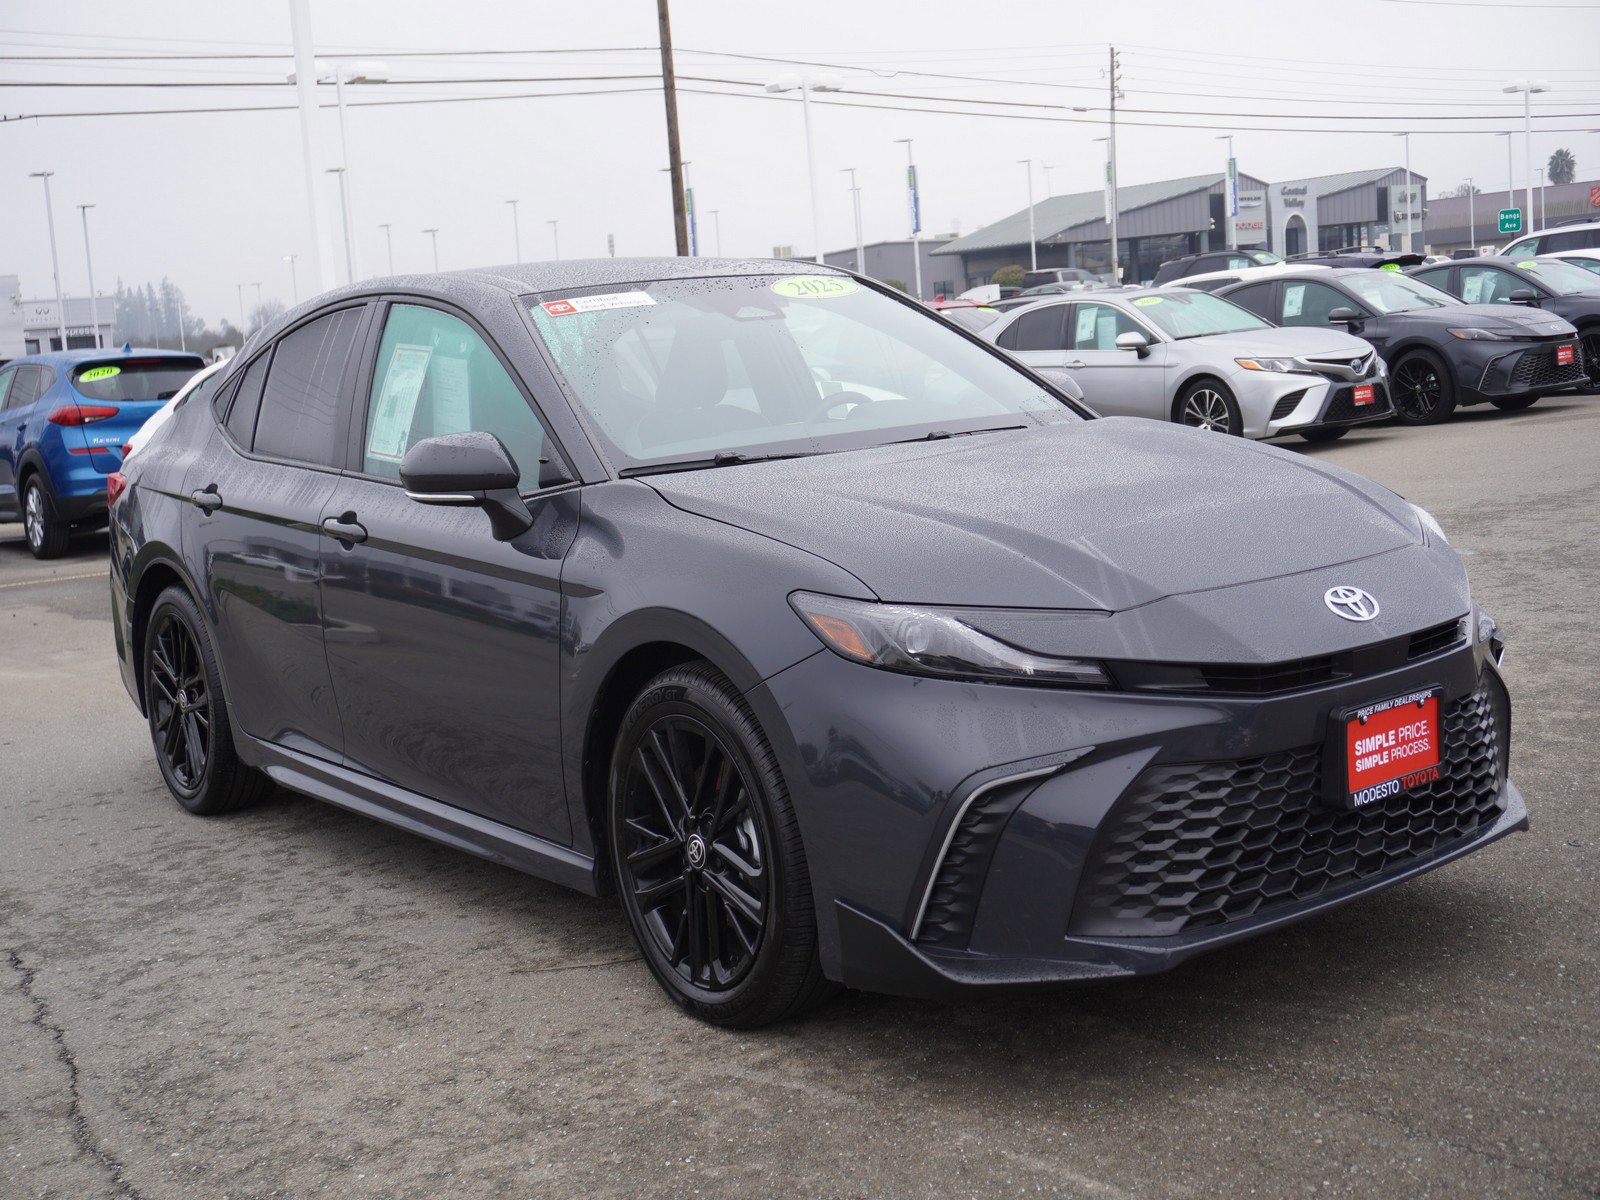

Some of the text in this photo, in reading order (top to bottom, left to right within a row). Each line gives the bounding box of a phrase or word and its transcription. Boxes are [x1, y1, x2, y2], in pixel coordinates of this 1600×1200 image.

[787, 279, 844, 295] 2025
[87, 367, 113, 380] 2020
[1357, 690, 1432, 718] PRICE FAMILY DEALERSHIPS
[1354, 720, 1430, 756] SIMPLE PRICE.
[1355, 738, 1431, 772] SIMPLE PROCESS.
[1354, 767, 1439, 807] MODESTO TOYOTA
